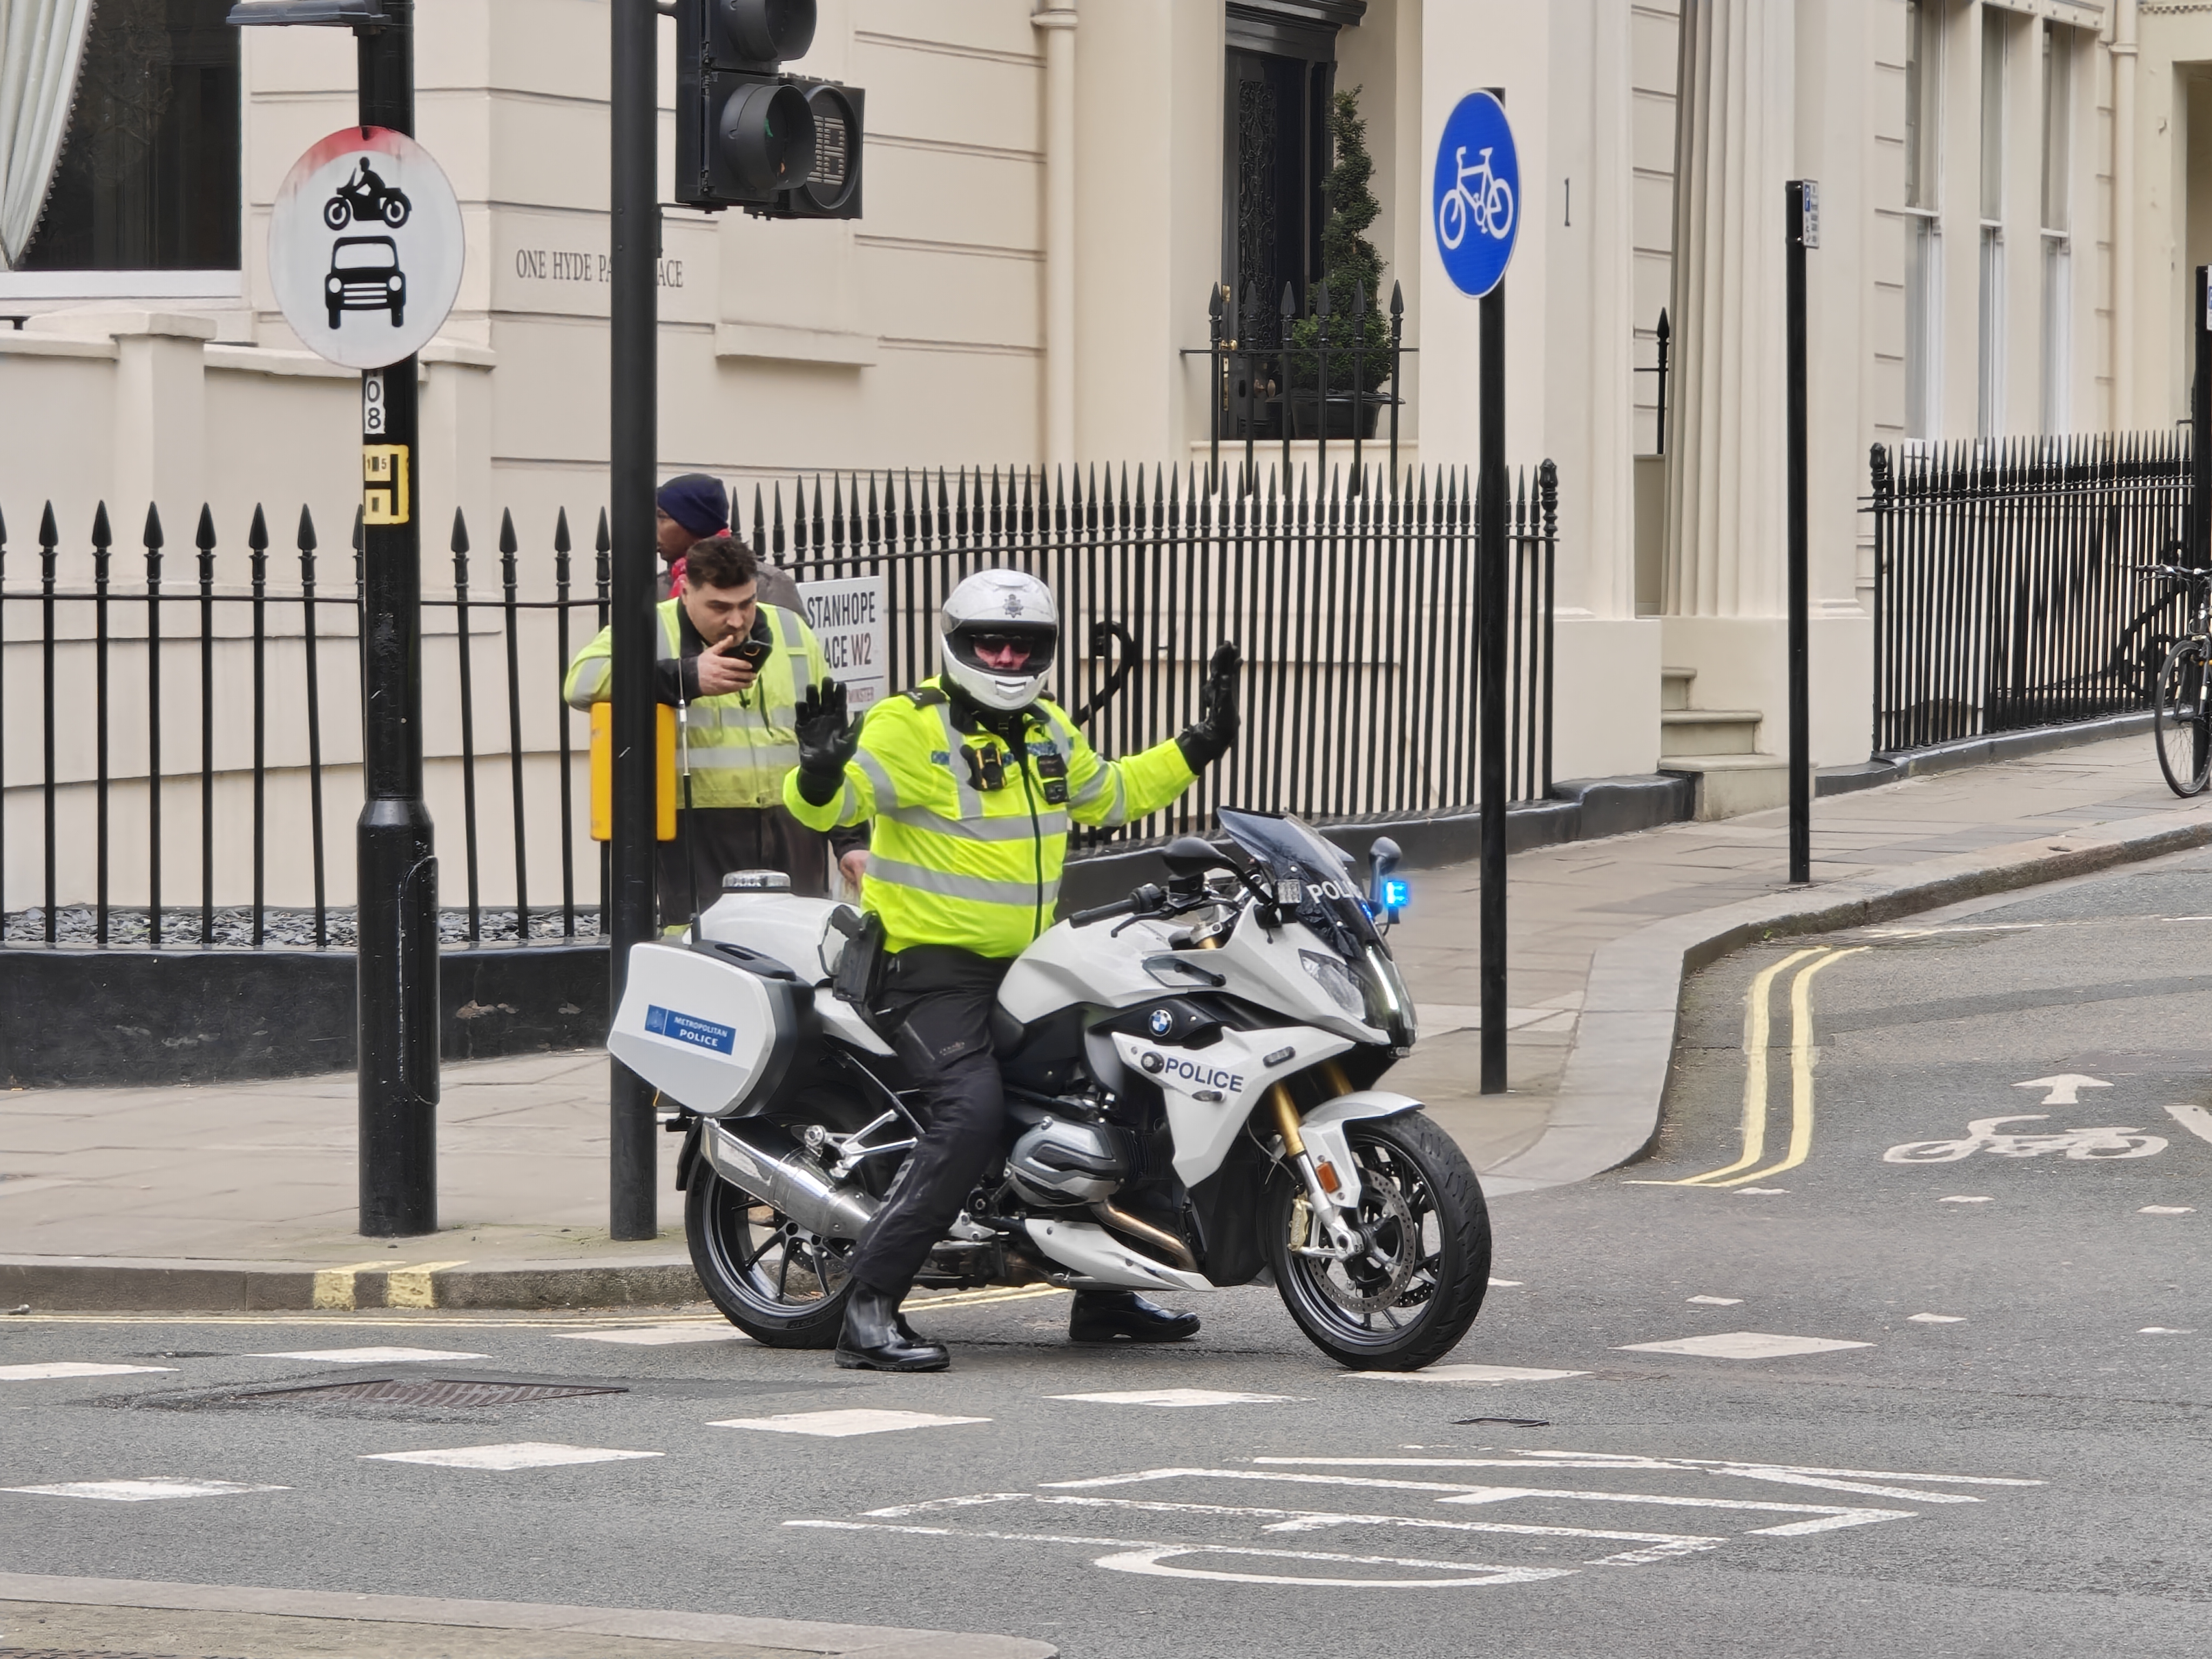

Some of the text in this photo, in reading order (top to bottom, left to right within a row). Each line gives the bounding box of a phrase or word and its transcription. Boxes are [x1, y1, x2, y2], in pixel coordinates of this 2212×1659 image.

[516, 249, 683, 288] ONE HYDE PA ACE
[367, 373, 381, 429] 08
[807, 591, 875, 630] STANHOPE
[824, 632, 872, 669] ACE W2
[674, 1016, 728, 1038] METROPOLITAN
[679, 1029, 718, 1047] POLICE
[1165, 1057, 1244, 1092] POLICE
